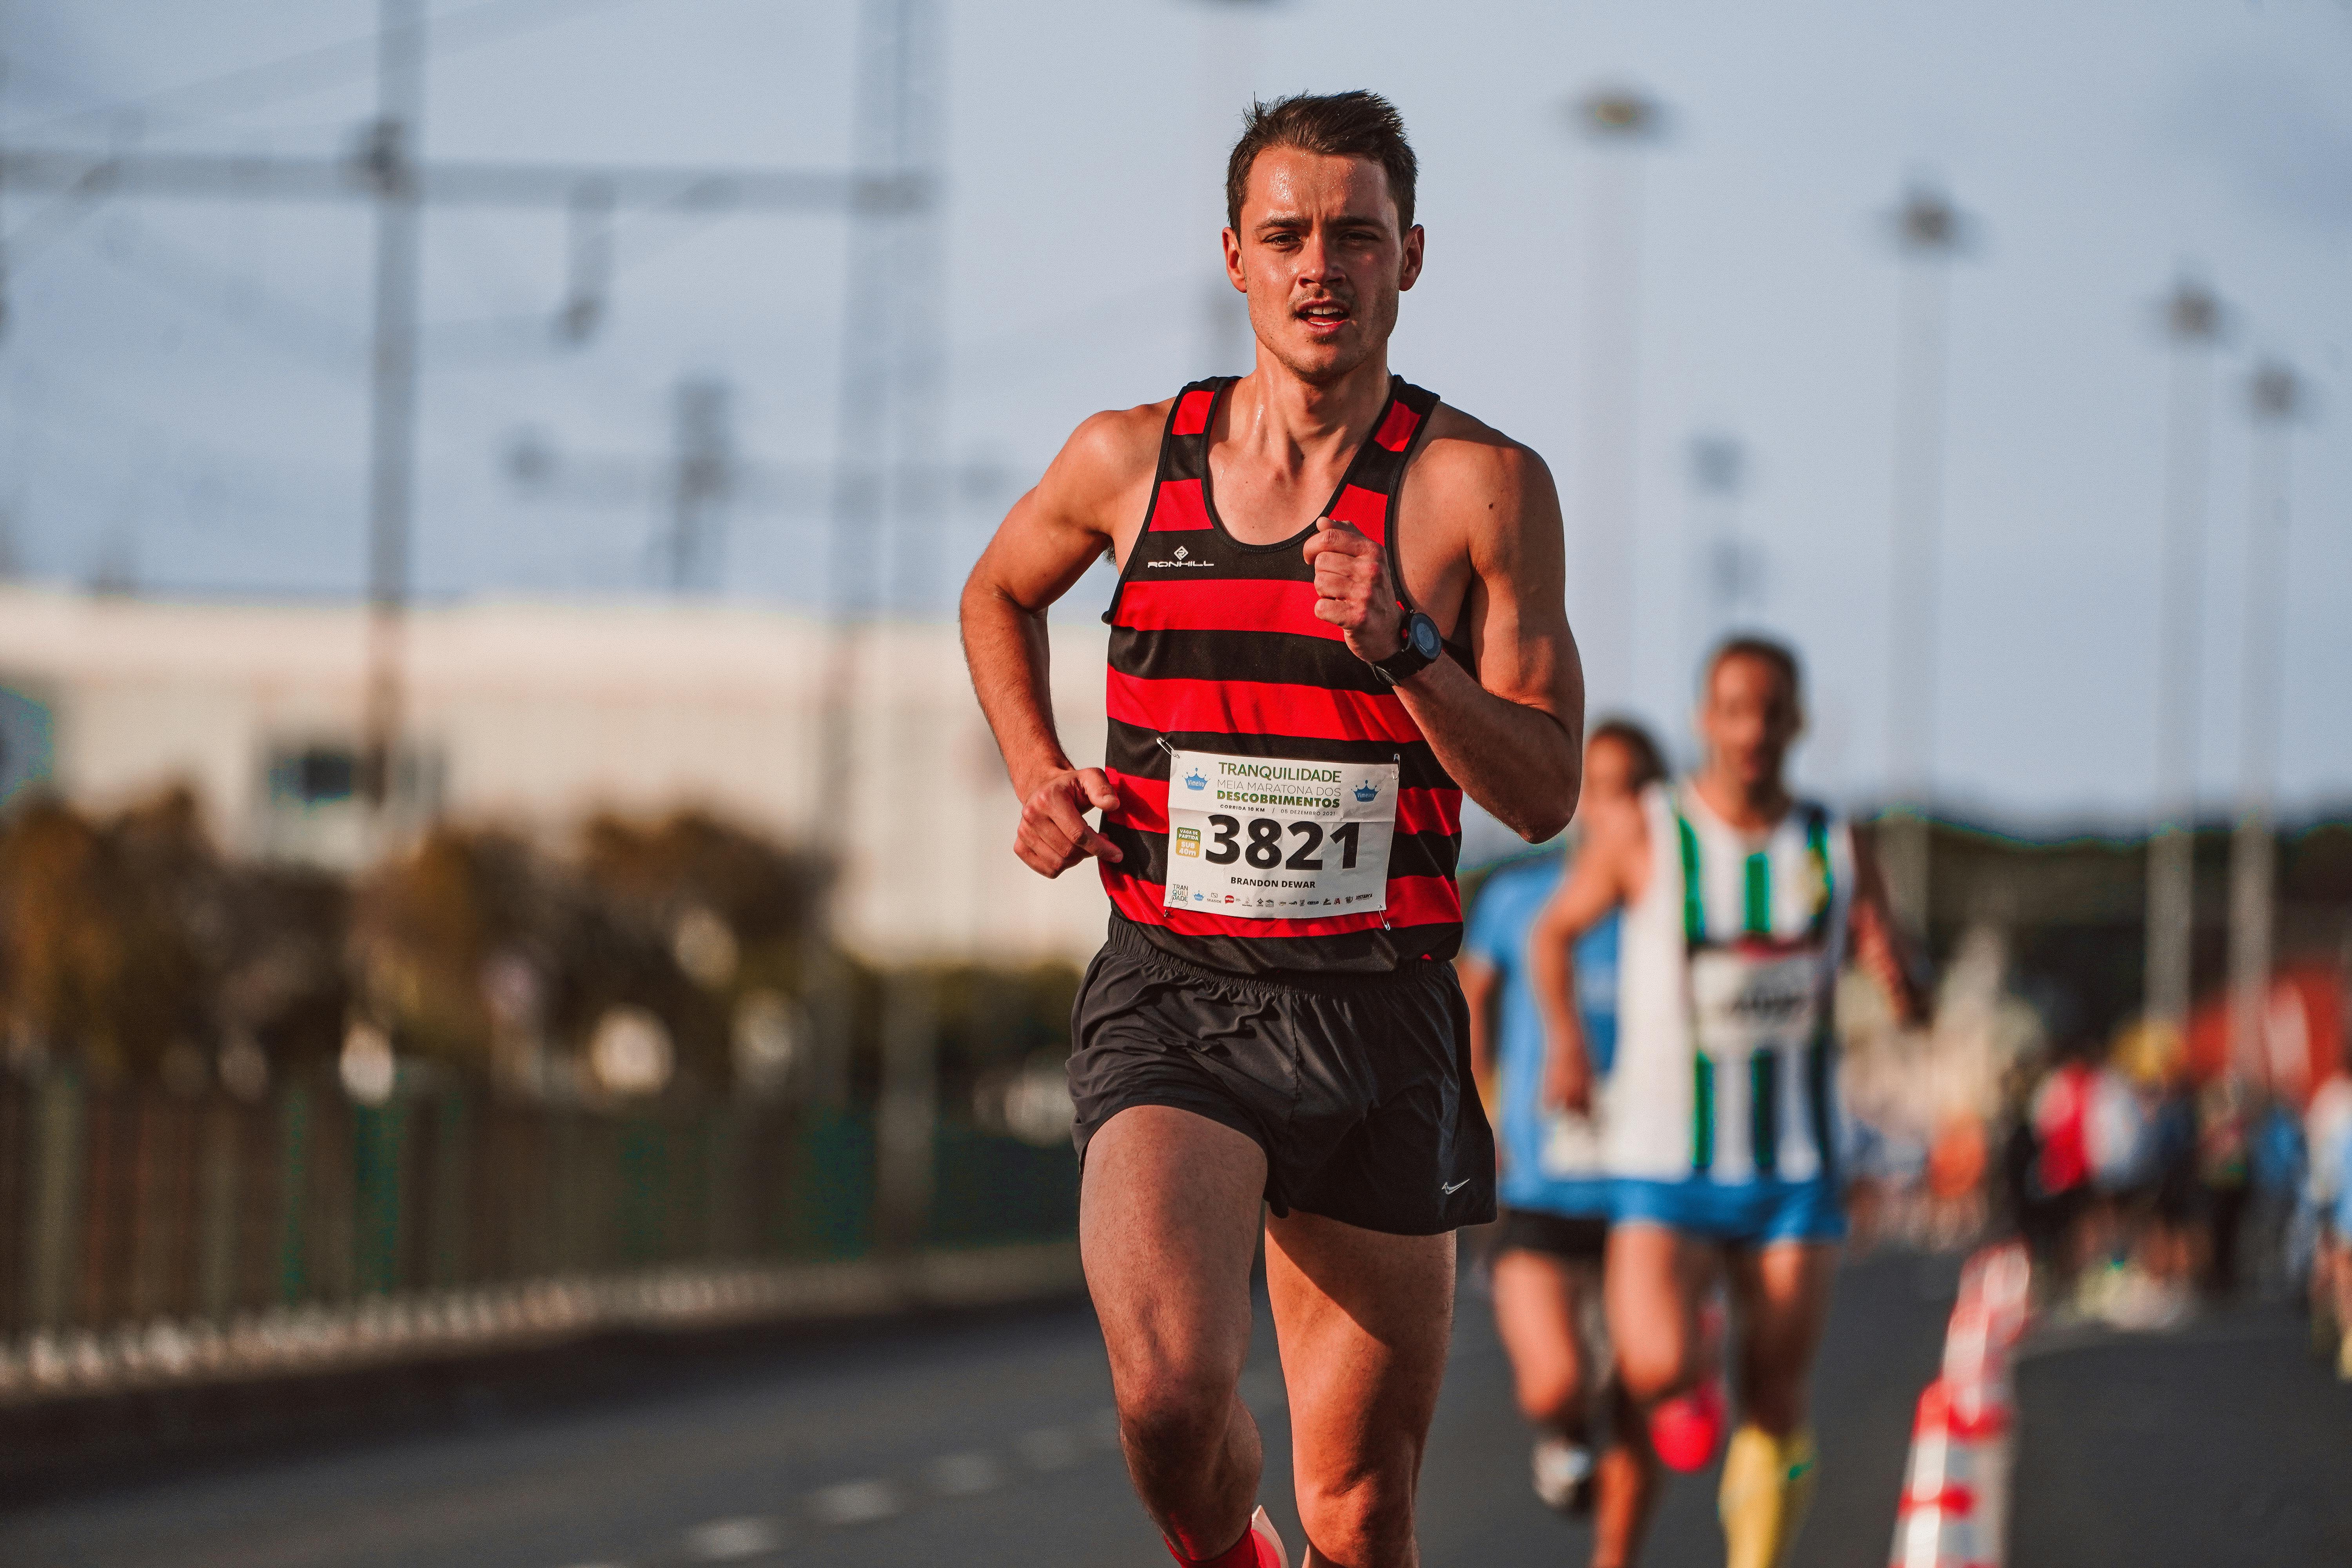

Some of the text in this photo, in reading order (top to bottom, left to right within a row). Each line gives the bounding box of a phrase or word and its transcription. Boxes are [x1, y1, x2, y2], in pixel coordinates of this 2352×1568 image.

[1218, 762, 1341, 783] TRANQUILIDADE
[1218, 779, 1341, 797] MEIA MARATONA DOS
[1217, 790, 1340, 808] DESCOBRIMENTOS
[1205, 814, 1360, 870] 3821
[1179, 848, 1196, 856] 40m
[1230, 877, 1316, 888] BRANDON DEWAR
